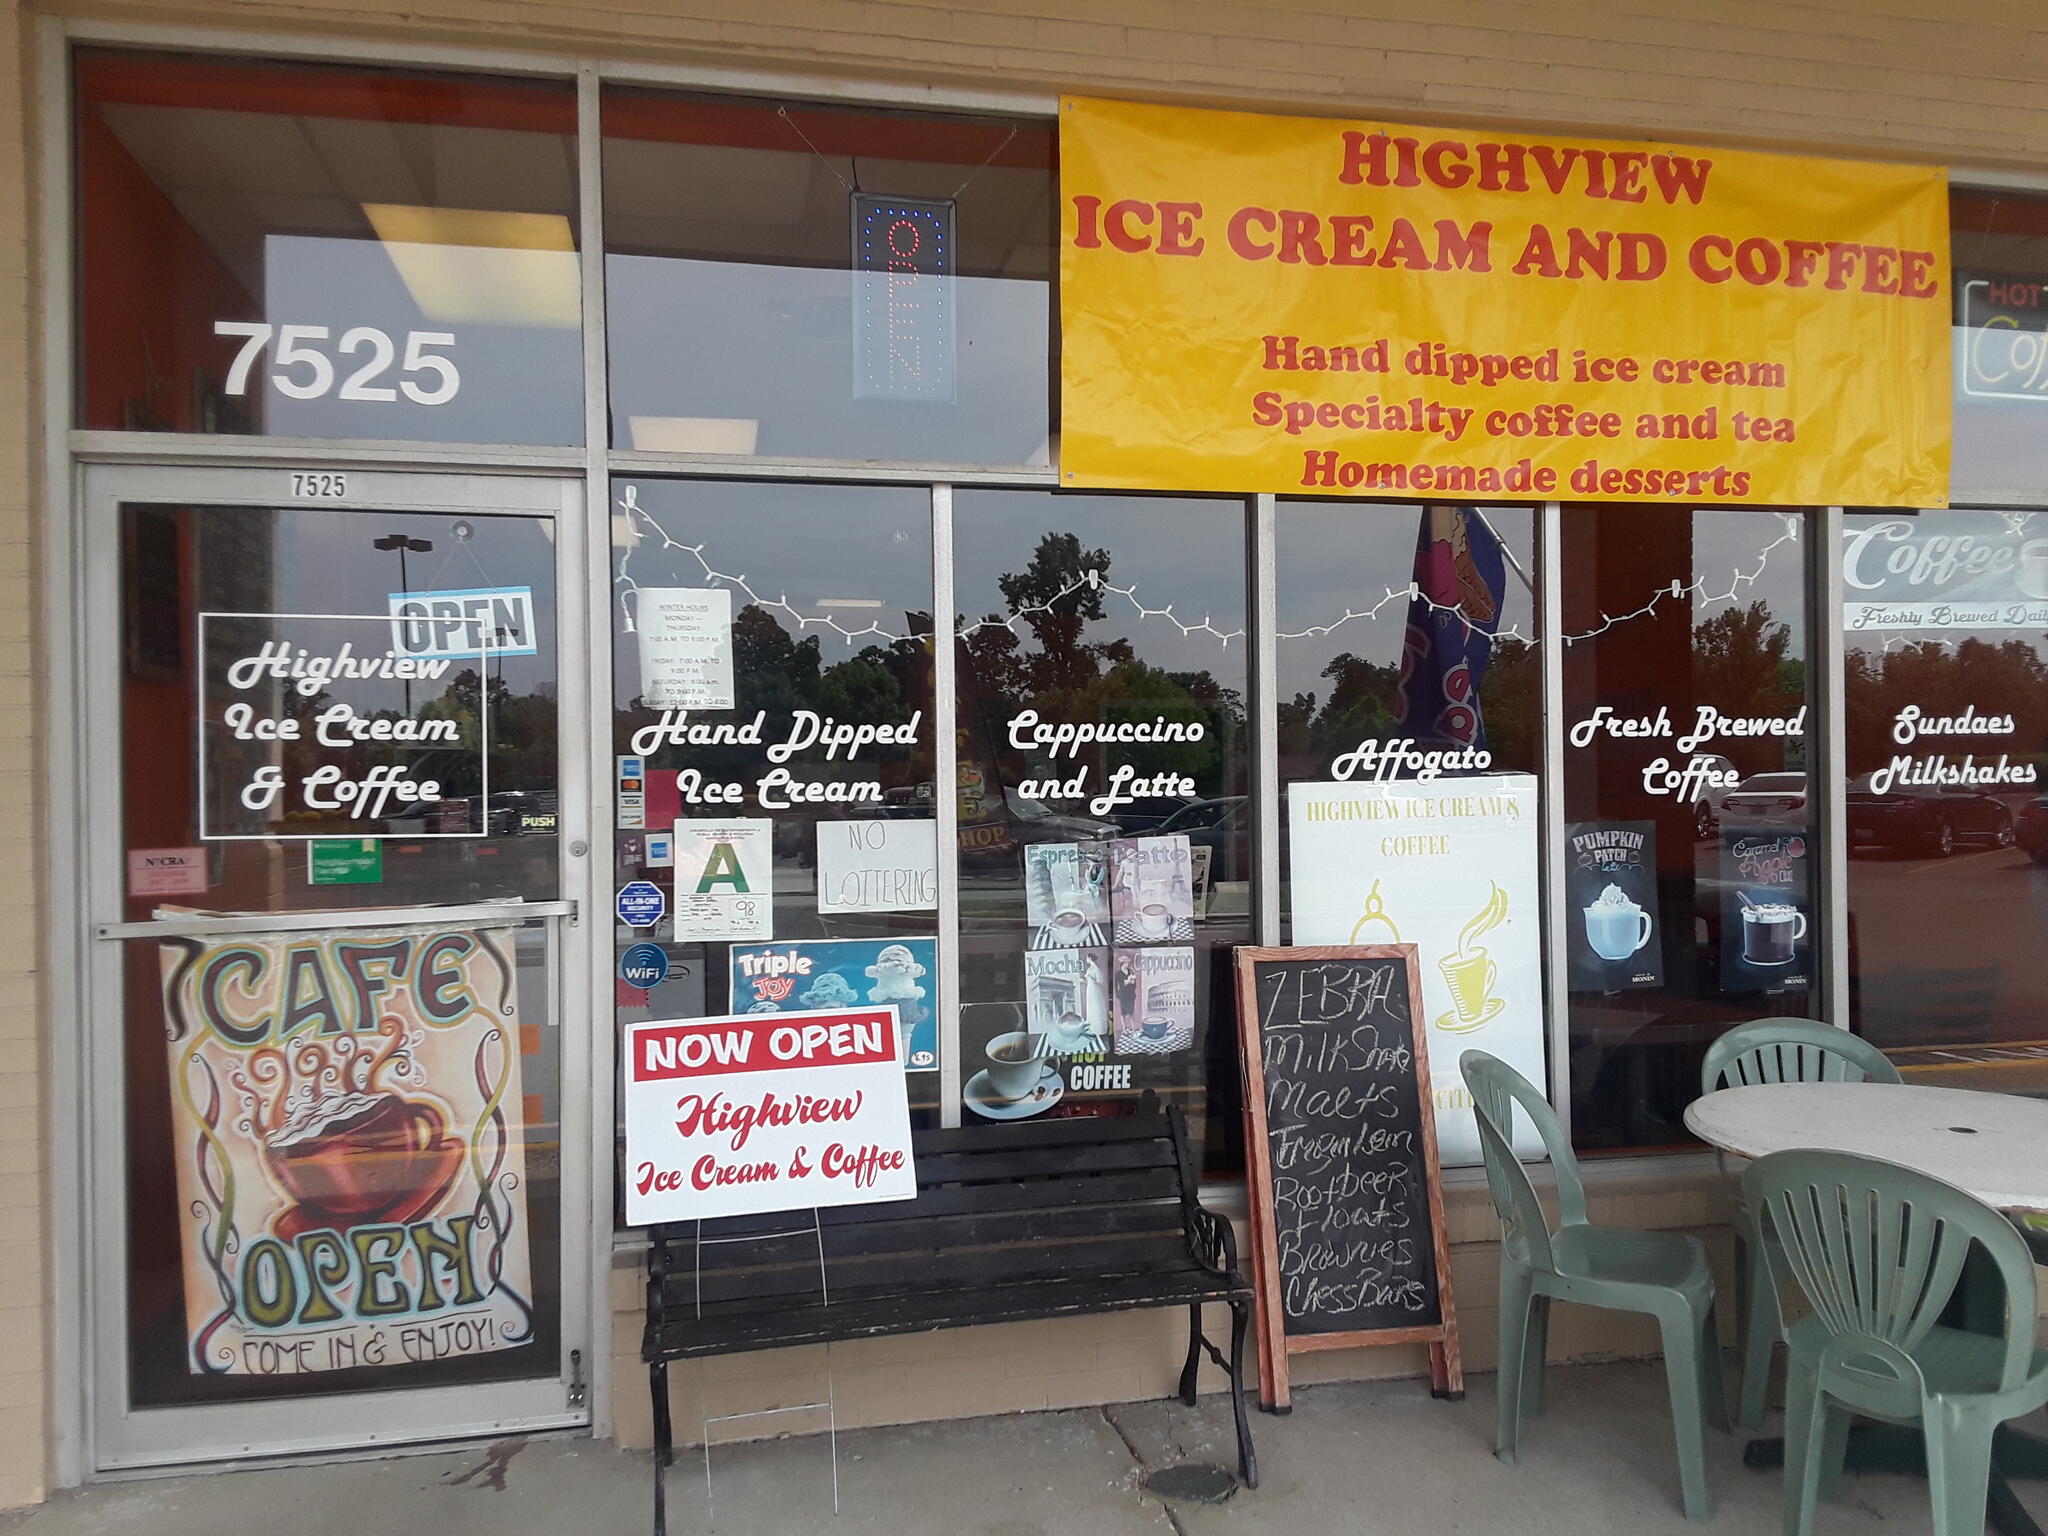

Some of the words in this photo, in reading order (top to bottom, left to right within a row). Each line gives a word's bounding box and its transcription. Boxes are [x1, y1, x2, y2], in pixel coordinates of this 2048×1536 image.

[1338, 130, 1713, 206] HIGHVIEW
[1072, 194, 1206, 258] ICE
[1226, 206, 1493, 273] CREAM
[1511, 223, 1668, 282] AND
[1687, 234, 1940, 300] COFFEE
[888, 218, 920, 381] OPEN
[1989, 281, 2042, 307] HOT
[213, 320, 461, 406] 7525
[1261, 335, 1390, 374] Hand
[1403, 341, 1560, 387] dipped
[1572, 350, 1641, 383] ice
[1652, 358, 1786, 388] cream
[1973, 314, 2048, 391] Cof
[1251, 391, 1475, 442] Specialty
[1484, 404, 1622, 439] coffee
[1635, 407, 1719, 440] and
[1732, 410, 1797, 443] tea
[292, 473, 345, 497] 7525
[1300, 450, 1558, 496] Homemade
[1569, 457, 1752, 498] desserts
[1843, 520, 2015, 590] Coffee
[397, 597, 528, 654] OPEN
[1853, 606, 1923, 629] Freshly
[1928, 604, 1999, 625] Brewed
[2003, 603, 2048, 625] Dail
[227, 640, 452, 697] Highview
[224, 703, 301, 741] Ice
[315, 702, 461, 748] Cream
[631, 710, 767, 757] Hand
[766, 710, 922, 764] Dipped
[1007, 709, 1204, 759] Cappuccino
[1570, 706, 1674, 748] Fresh
[1676, 704, 1808, 754] Brewed
[1893, 704, 2016, 745] Sundaes
[1330, 738, 1492, 785] Affogato
[1641, 757, 1741, 804] Coffee
[1870, 754, 2037, 796] Milkshakes
[241, 765, 285, 811] &
[301, 765, 442, 819] Coffee
[675, 768, 744, 805] Ice
[756, 767, 884, 810] Cream
[1017, 763, 1088, 800] and
[1088, 764, 1197, 816] Latte
[1306, 801, 1401, 822] HIGHVIEW
[1407, 798, 1435, 819] ICE
[1439, 797, 1502, 818] CREAM
[521, 816, 556, 827] PUSH
[849, 821, 886, 850] NO
[957, 826, 1004, 847] HOP
[1572, 830, 1645, 853] PUMPKIN
[695, 842, 751, 894] A
[1380, 834, 1450, 857] COFFEE
[1593, 848, 1629, 863] PATCH
[1732, 837, 1781, 858] Caramel
[824, 868, 937, 907] LOITERING
[1739, 855, 1793, 885] Apple
[735, 900, 756, 917] 98
[625, 967, 660, 979] WiFi
[738, 949, 813, 978] Triple
[1026, 954, 1086, 976] Mocha
[1132, 951, 1193, 976] Cappuccino
[1631, 975, 1656, 983] MONIN
[202, 933, 476, 1046] CAFE
[1264, 963, 1406, 1031] ZEBRA
[645, 1029, 754, 1073] NOW
[768, 1021, 884, 1061] OPEN
[1070, 1064, 1132, 1091] COFFEE
[675, 1089, 863, 1152] Highview
[636, 1160, 683, 1197] Ice
[690, 1153, 780, 1192] Cream
[788, 1145, 814, 1179] &
[820, 1142, 905, 1189] Coffee
[239, 1216, 489, 1329] OPEN
[243, 1340, 316, 1375] COME
[328, 1333, 357, 1370] IN
[362, 1330, 389, 1366] &
[400, 1316, 497, 1363] ENJOY!
